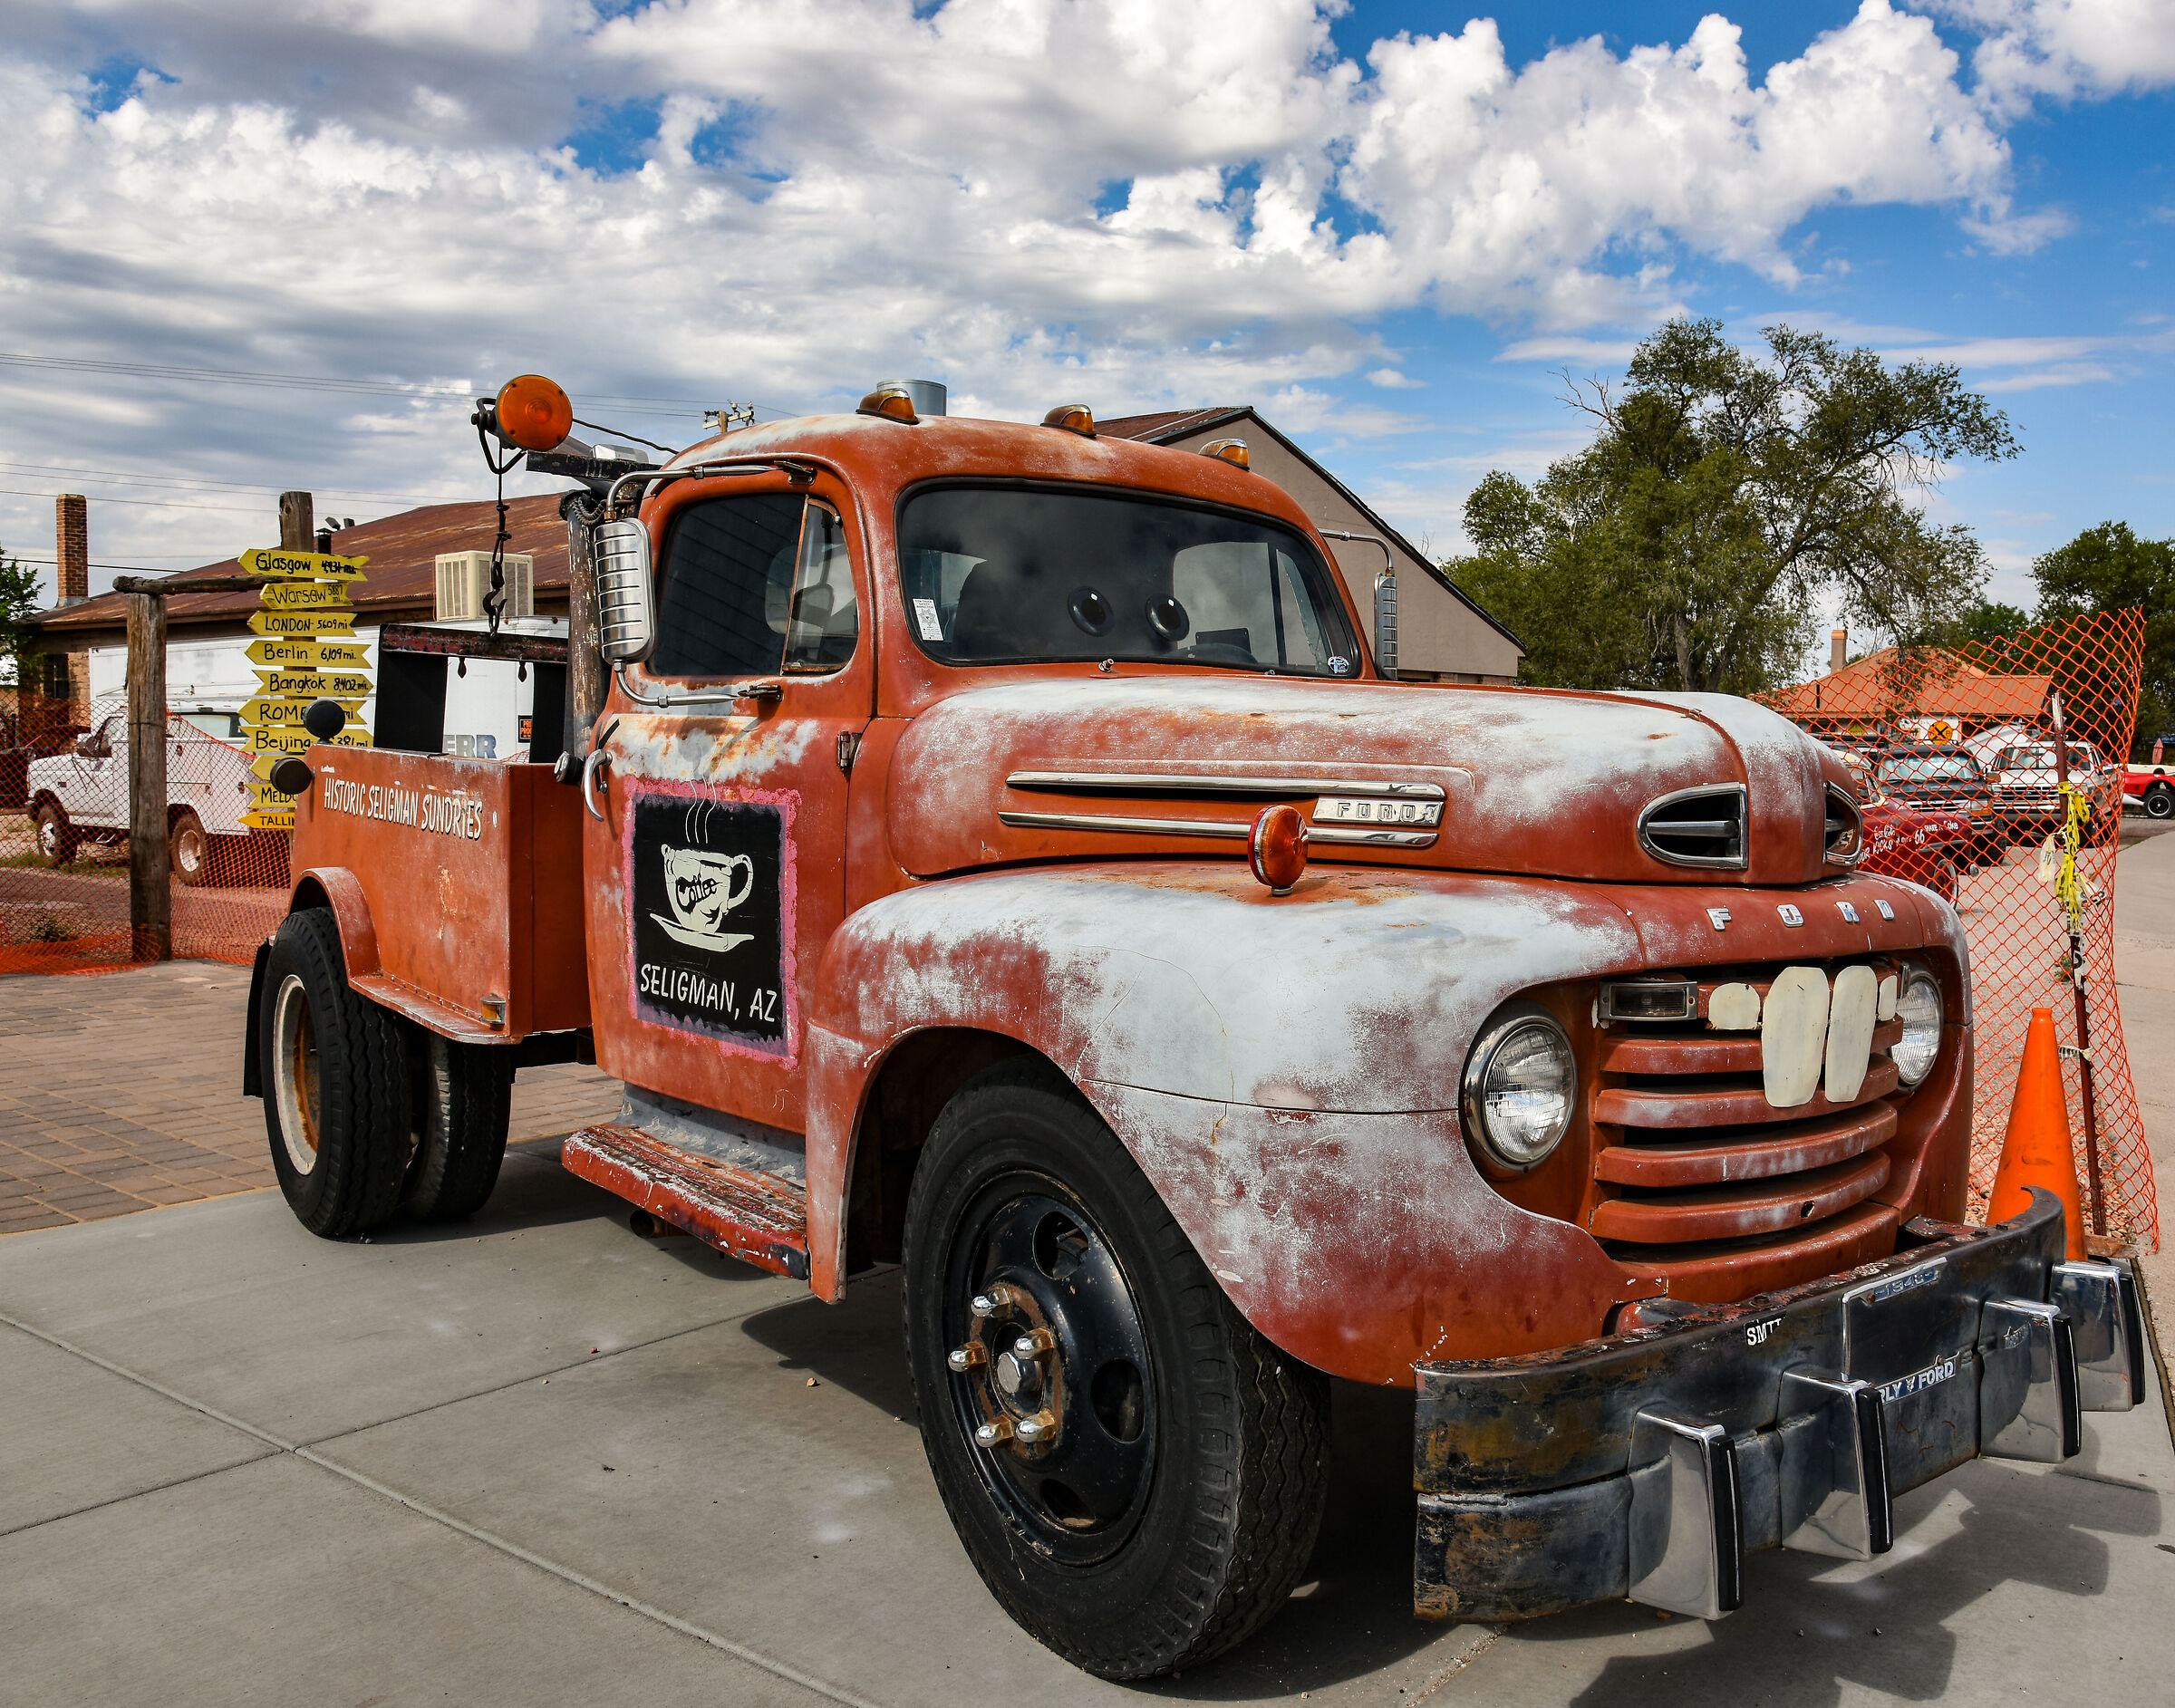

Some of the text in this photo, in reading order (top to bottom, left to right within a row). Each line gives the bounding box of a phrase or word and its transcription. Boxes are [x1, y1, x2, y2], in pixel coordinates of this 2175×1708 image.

[256, 552, 312, 574] Glasgow
[273, 588, 326, 604] Warsaw
[338, 620, 348, 630] mi
[264, 643, 308, 661] Berlin
[320, 647, 343, 662] 6,109
[269, 673, 327, 694] Bangkok
[256, 730, 311, 752] Beijing
[324, 777, 483, 841] HISTORIC SELIGMAN SUNDRIES
[1915, 829, 1925, 844] 66
[676, 873, 717, 907] Coffee
[1706, 899, 1896, 931] FORD
[640, 963, 778, 1023] SELIGMAN, AZ
[1919, 1361, 1954, 1389] FORD
